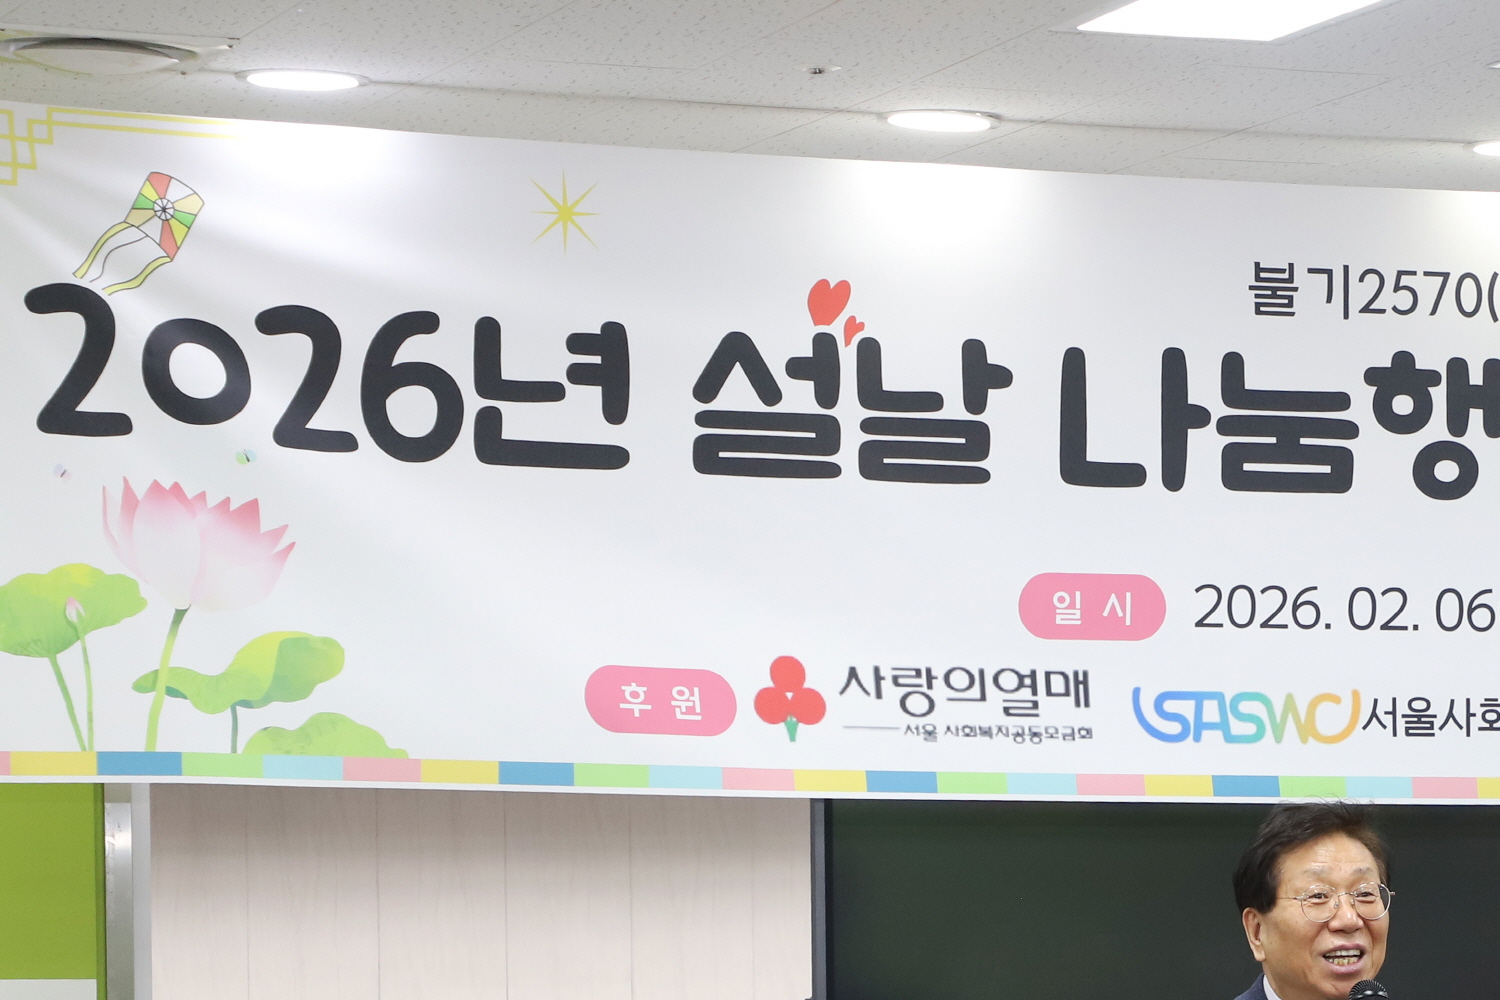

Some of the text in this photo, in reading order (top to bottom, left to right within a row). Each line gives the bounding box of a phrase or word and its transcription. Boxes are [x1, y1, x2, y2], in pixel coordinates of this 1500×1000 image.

[1249, 262, 1498, 322] 불기2570(
[25, 283, 629, 469] 2026년
[693, 332, 1012, 484] 설날
[1195, 584, 1330, 629] 2026.
[1348, 587, 1418, 630] 02.
[840, 666, 1090, 717] 사랑의열매
[905, 725, 1092, 744] 서울 사회복지공동모금회
